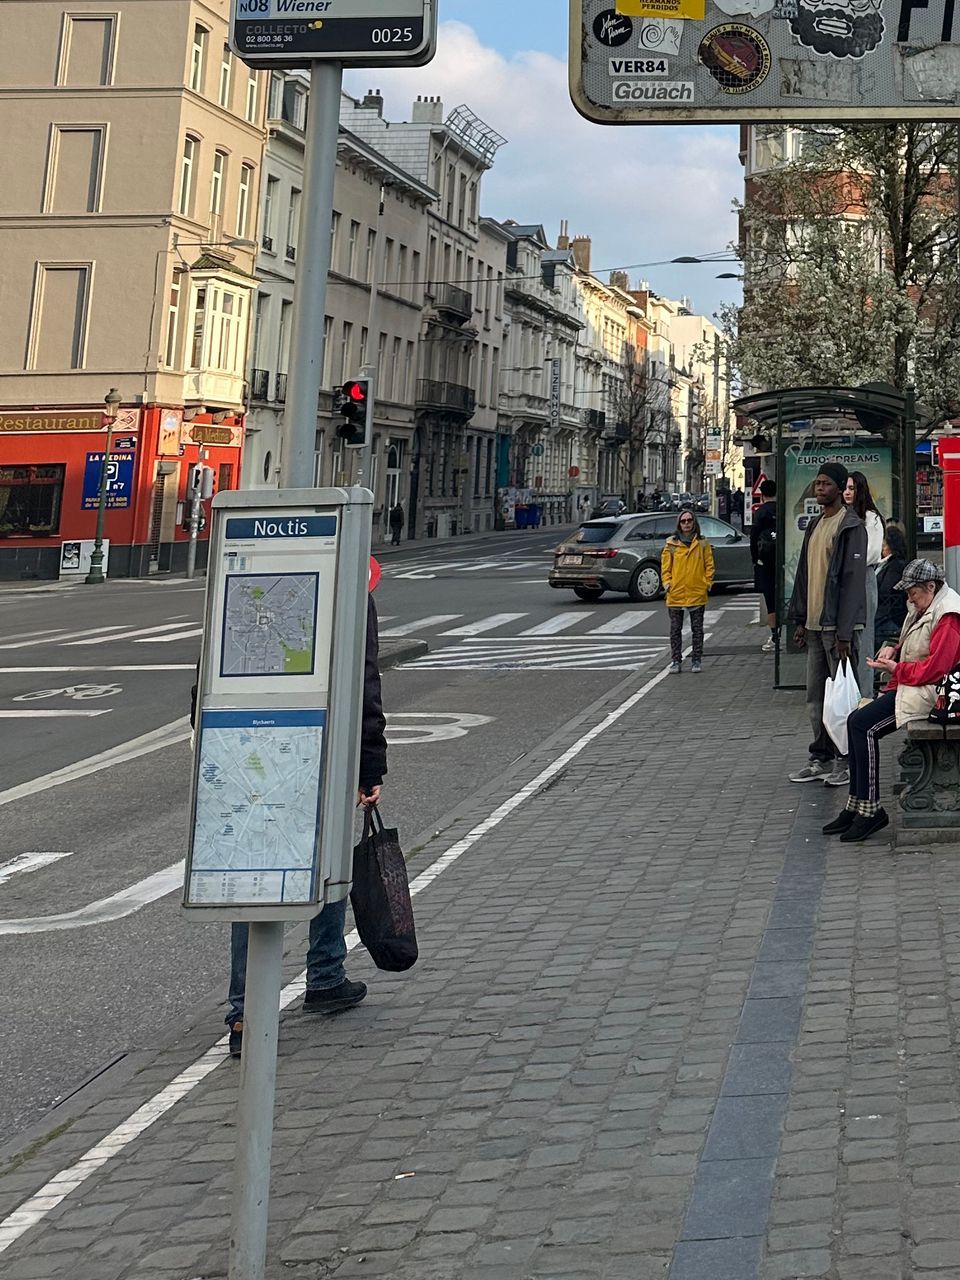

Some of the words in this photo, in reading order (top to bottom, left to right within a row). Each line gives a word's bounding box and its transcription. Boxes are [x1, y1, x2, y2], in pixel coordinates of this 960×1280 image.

[641, 4, 679, 12] PERDIDOS
[246, 24, 307, 34] COLLECTO
[371, 27, 413, 44] 0025
[246, 35, 256, 43] 02
[257, 34, 271, 42] 800
[272, 34, 282, 42] 36
[283, 34, 293, 42] 36
[611, 60, 667, 73] VER84
[614, 82, 693, 101] Gouach
[551, 360, 560, 426] ELZENHOF
[253, 518, 308, 536] Noctis
